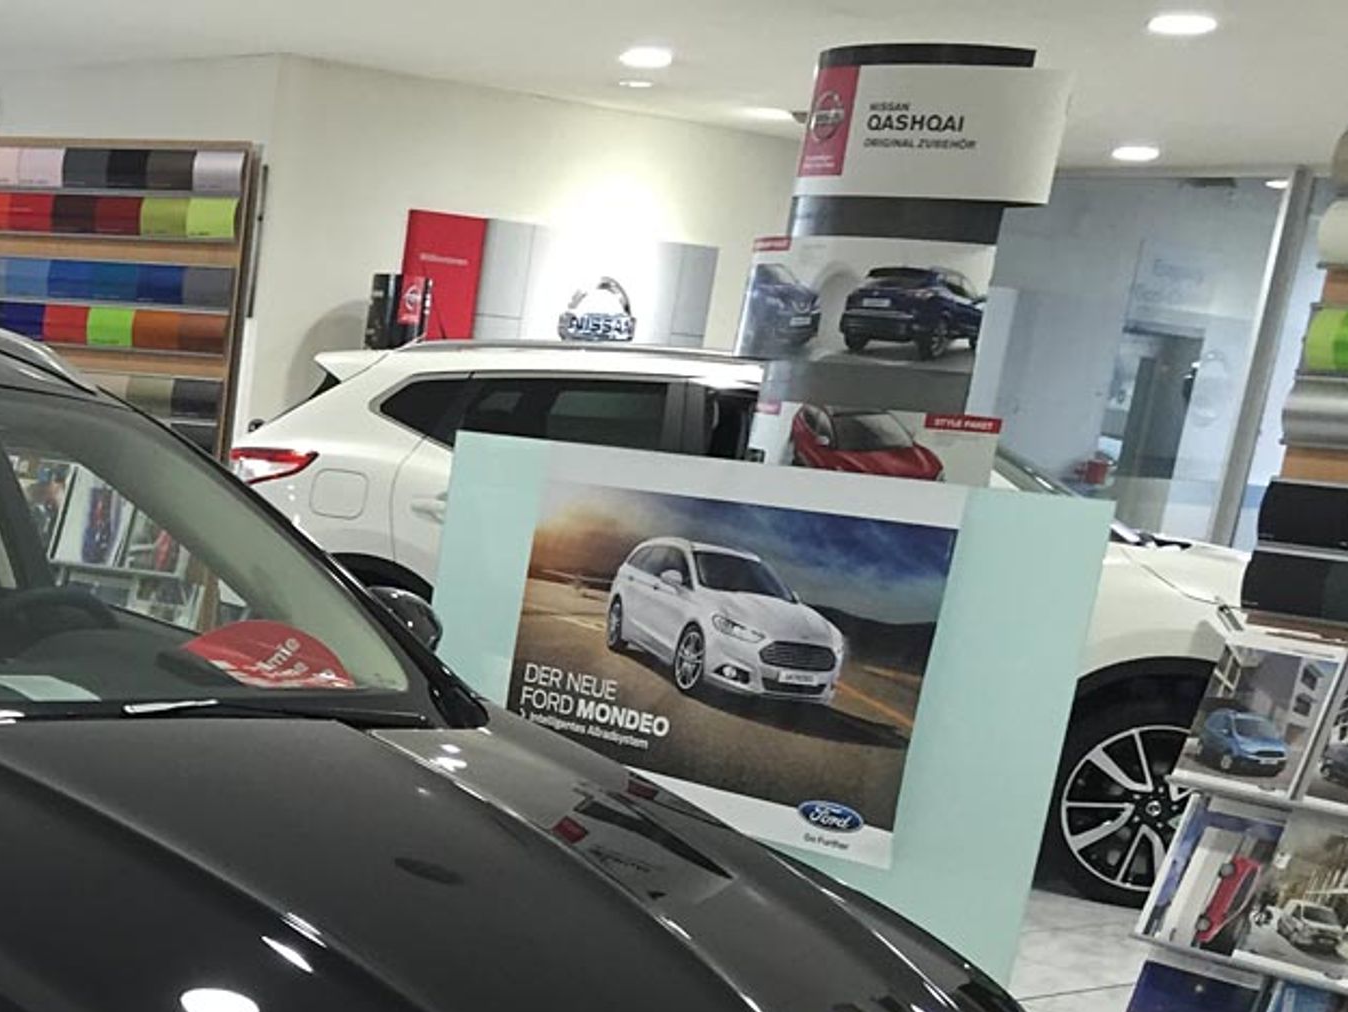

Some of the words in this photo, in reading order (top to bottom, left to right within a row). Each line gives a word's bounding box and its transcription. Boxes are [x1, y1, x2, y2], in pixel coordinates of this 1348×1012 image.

[866, 114, 965, 133] QASHQAI
[863, 138, 914, 148] ORIGINAL
[523, 663, 563, 688] DER
[565, 672, 618, 700] NEUE
[520, 686, 575, 715] FORD
[575, 698, 670, 737] MONDEO
